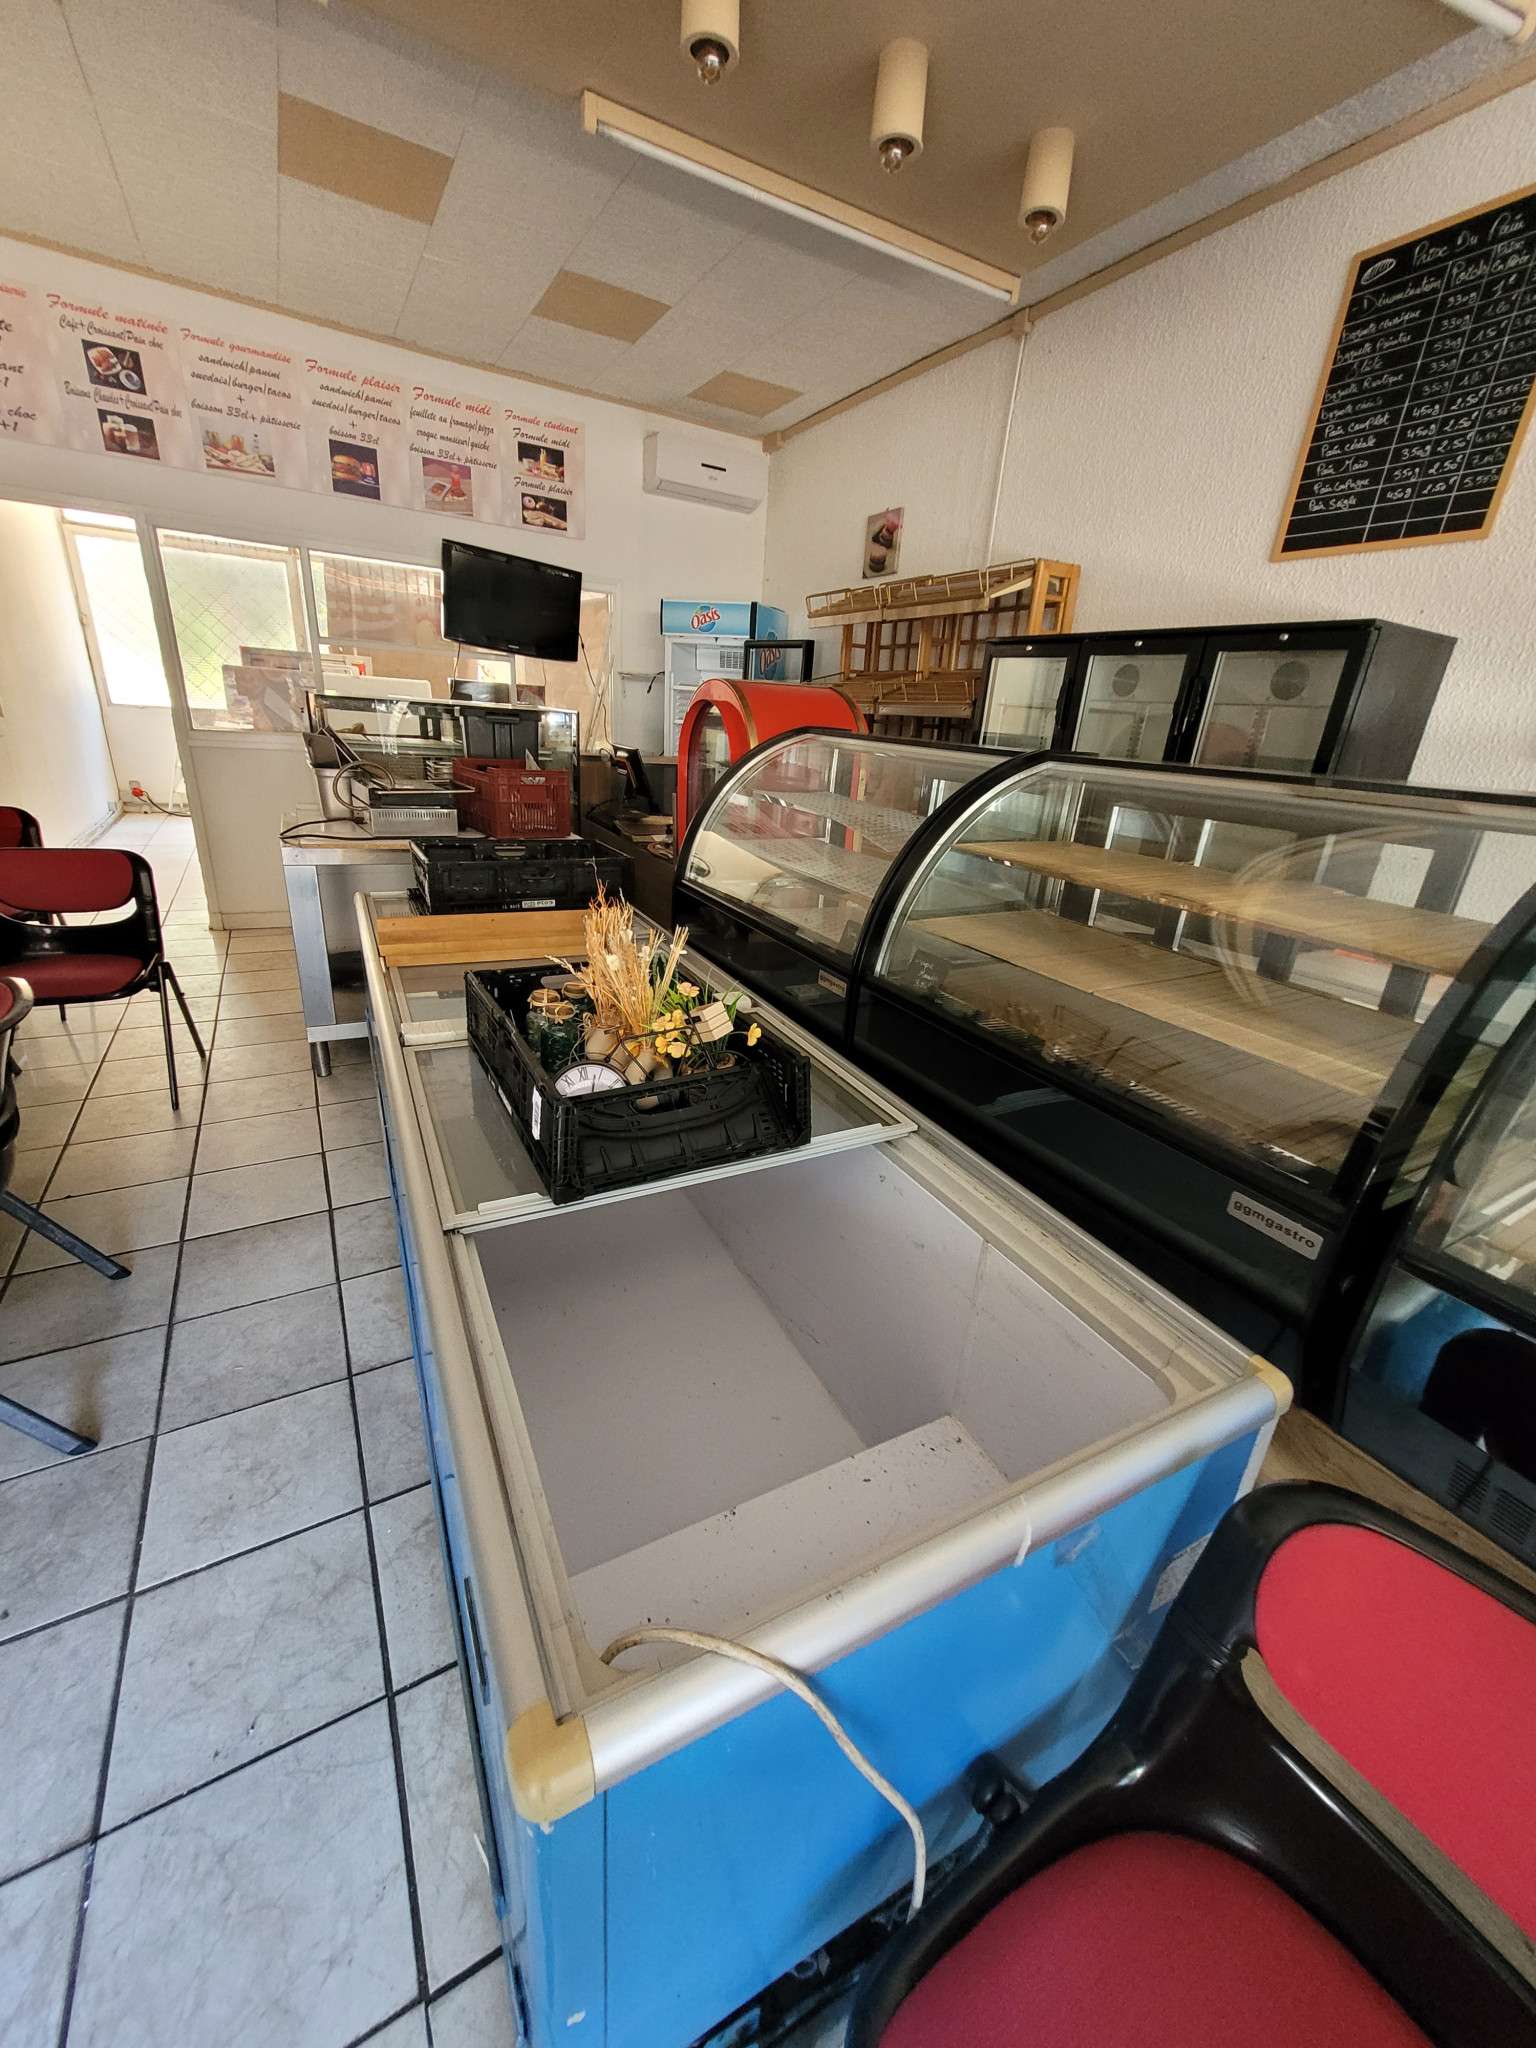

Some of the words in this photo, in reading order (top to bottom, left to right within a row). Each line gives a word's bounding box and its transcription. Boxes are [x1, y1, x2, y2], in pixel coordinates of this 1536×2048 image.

[46, 293, 109, 320] Formule
[180, 327, 225, 349] Formule
[229, 342, 292, 364] gourmandise
[305, 358, 357, 383] Formule
[360, 375, 401, 393] plaisir
[190, 399, 223, 415] boisson
[412, 386, 461, 409] Formule
[465, 403, 492, 416] midi
[7, 406, 38, 421] choc
[504, 409, 541, 427] Formule
[329, 425, 357, 441] boisson
[512, 427, 548, 444] Formule
[550, 437, 572, 449] midi
[513, 476, 546, 492] Formule
[547, 484, 574, 497] plaisir
[691, 607, 721, 630] Oasis
[1233, 1200, 1316, 1248] ggmgastro
